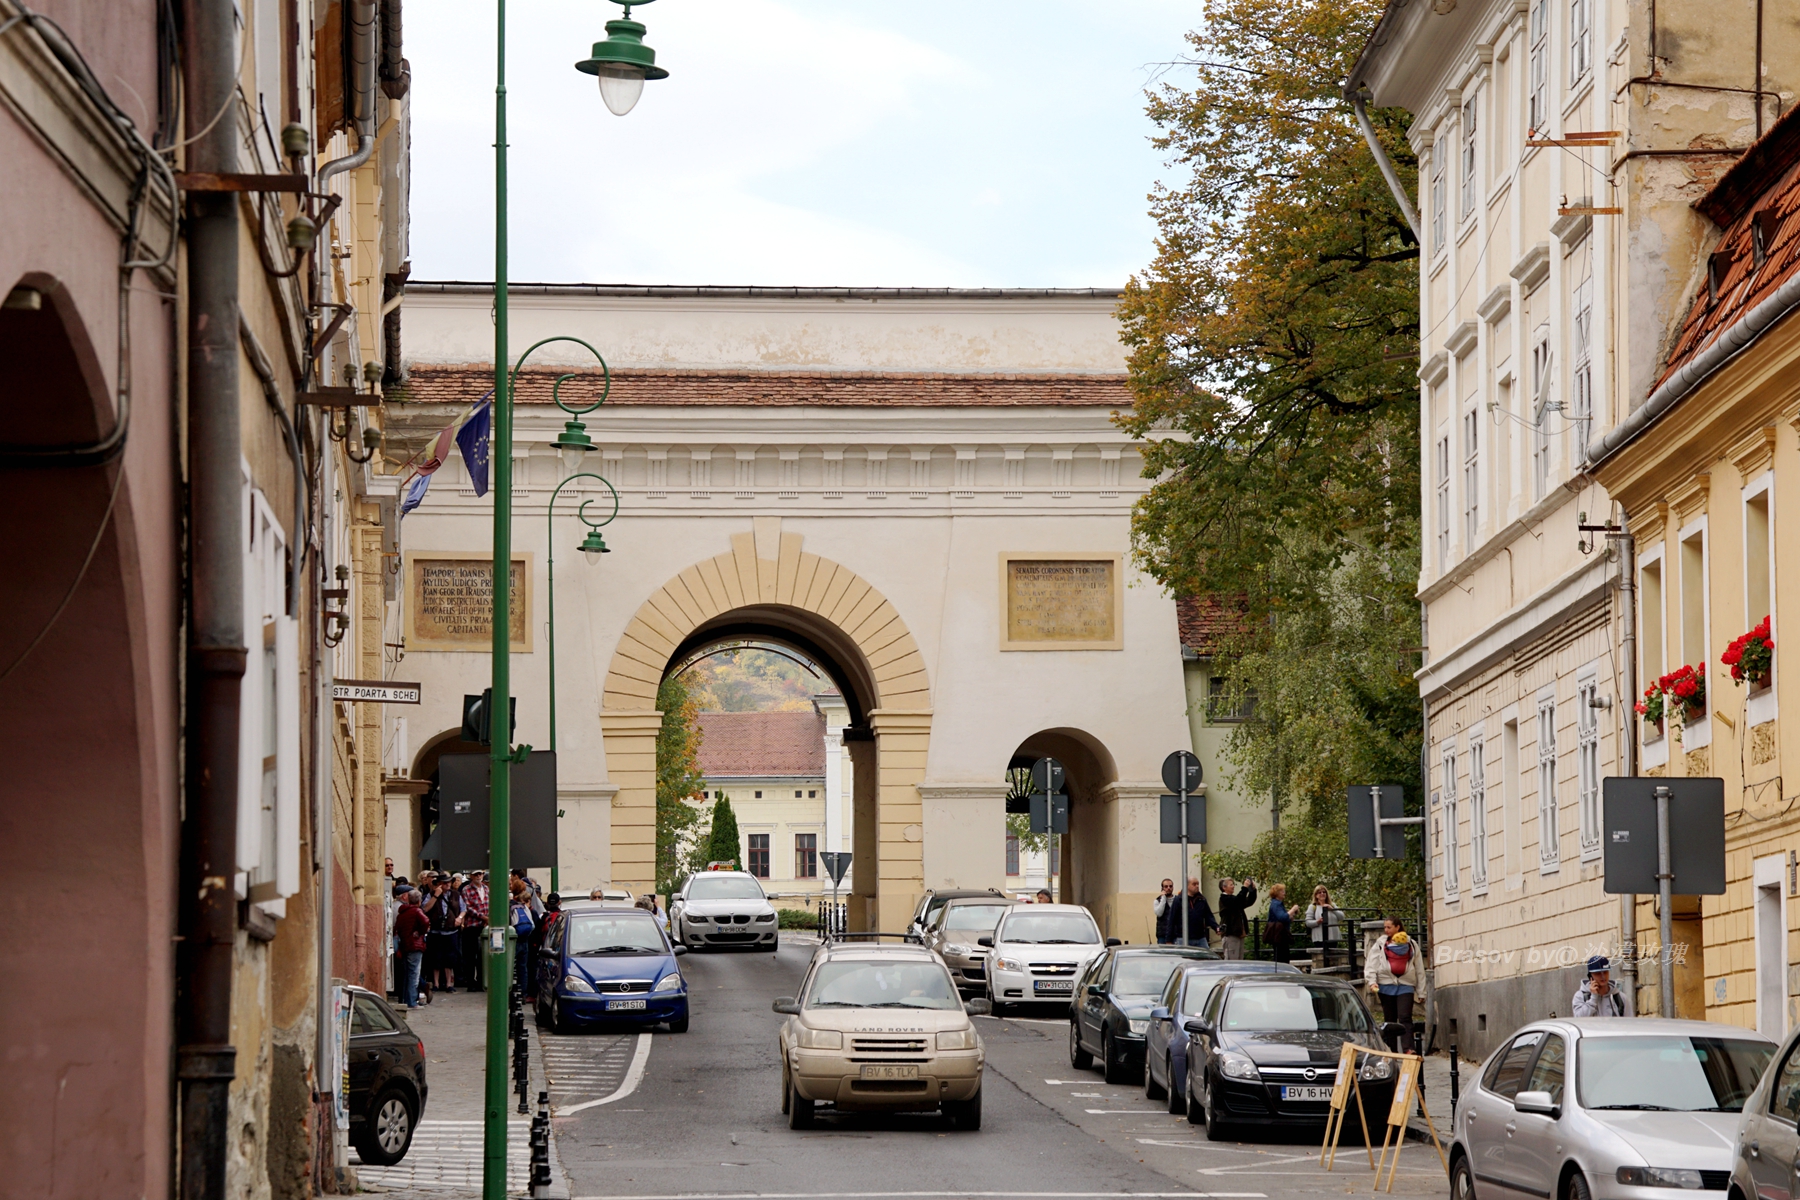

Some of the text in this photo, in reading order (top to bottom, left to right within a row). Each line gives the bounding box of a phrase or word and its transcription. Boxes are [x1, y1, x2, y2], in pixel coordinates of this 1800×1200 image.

[422, 568, 456, 577] TEMPORE
[355, 688, 387, 698] POARTA
[393, 690, 417, 700] SCHEI
[866, 1067, 914, 1077] BV 16 TLK
[1288, 1087, 1334, 1098] BV 16 HV
